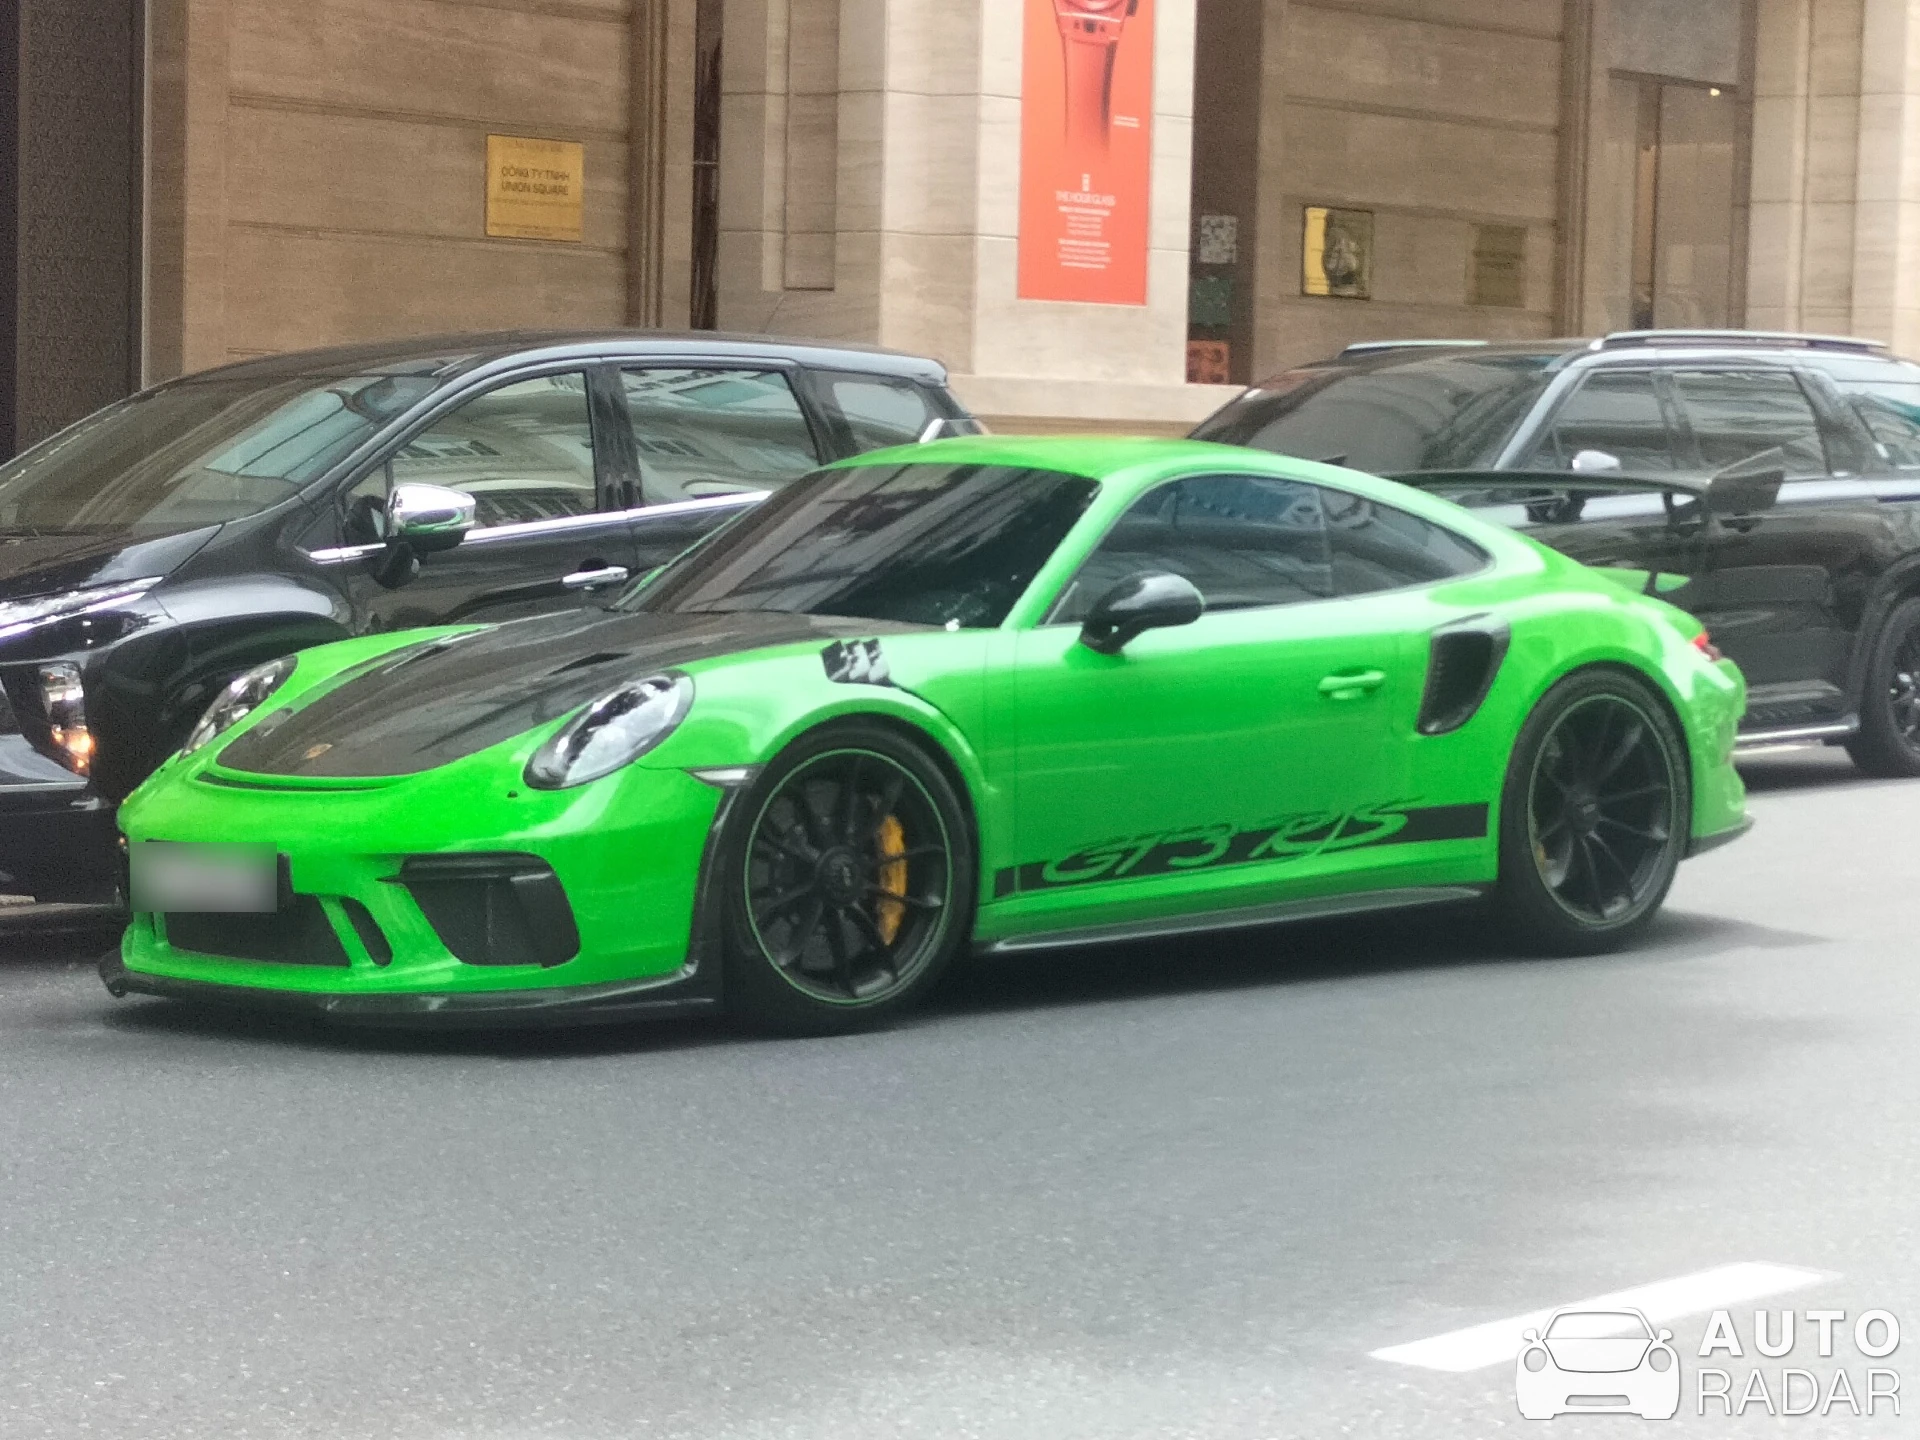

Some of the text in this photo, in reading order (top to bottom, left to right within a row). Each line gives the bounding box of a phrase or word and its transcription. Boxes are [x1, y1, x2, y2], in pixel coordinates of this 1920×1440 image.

[501, 180, 530, 193] UNION
[1043, 797, 1424, 882] GT3 RS
